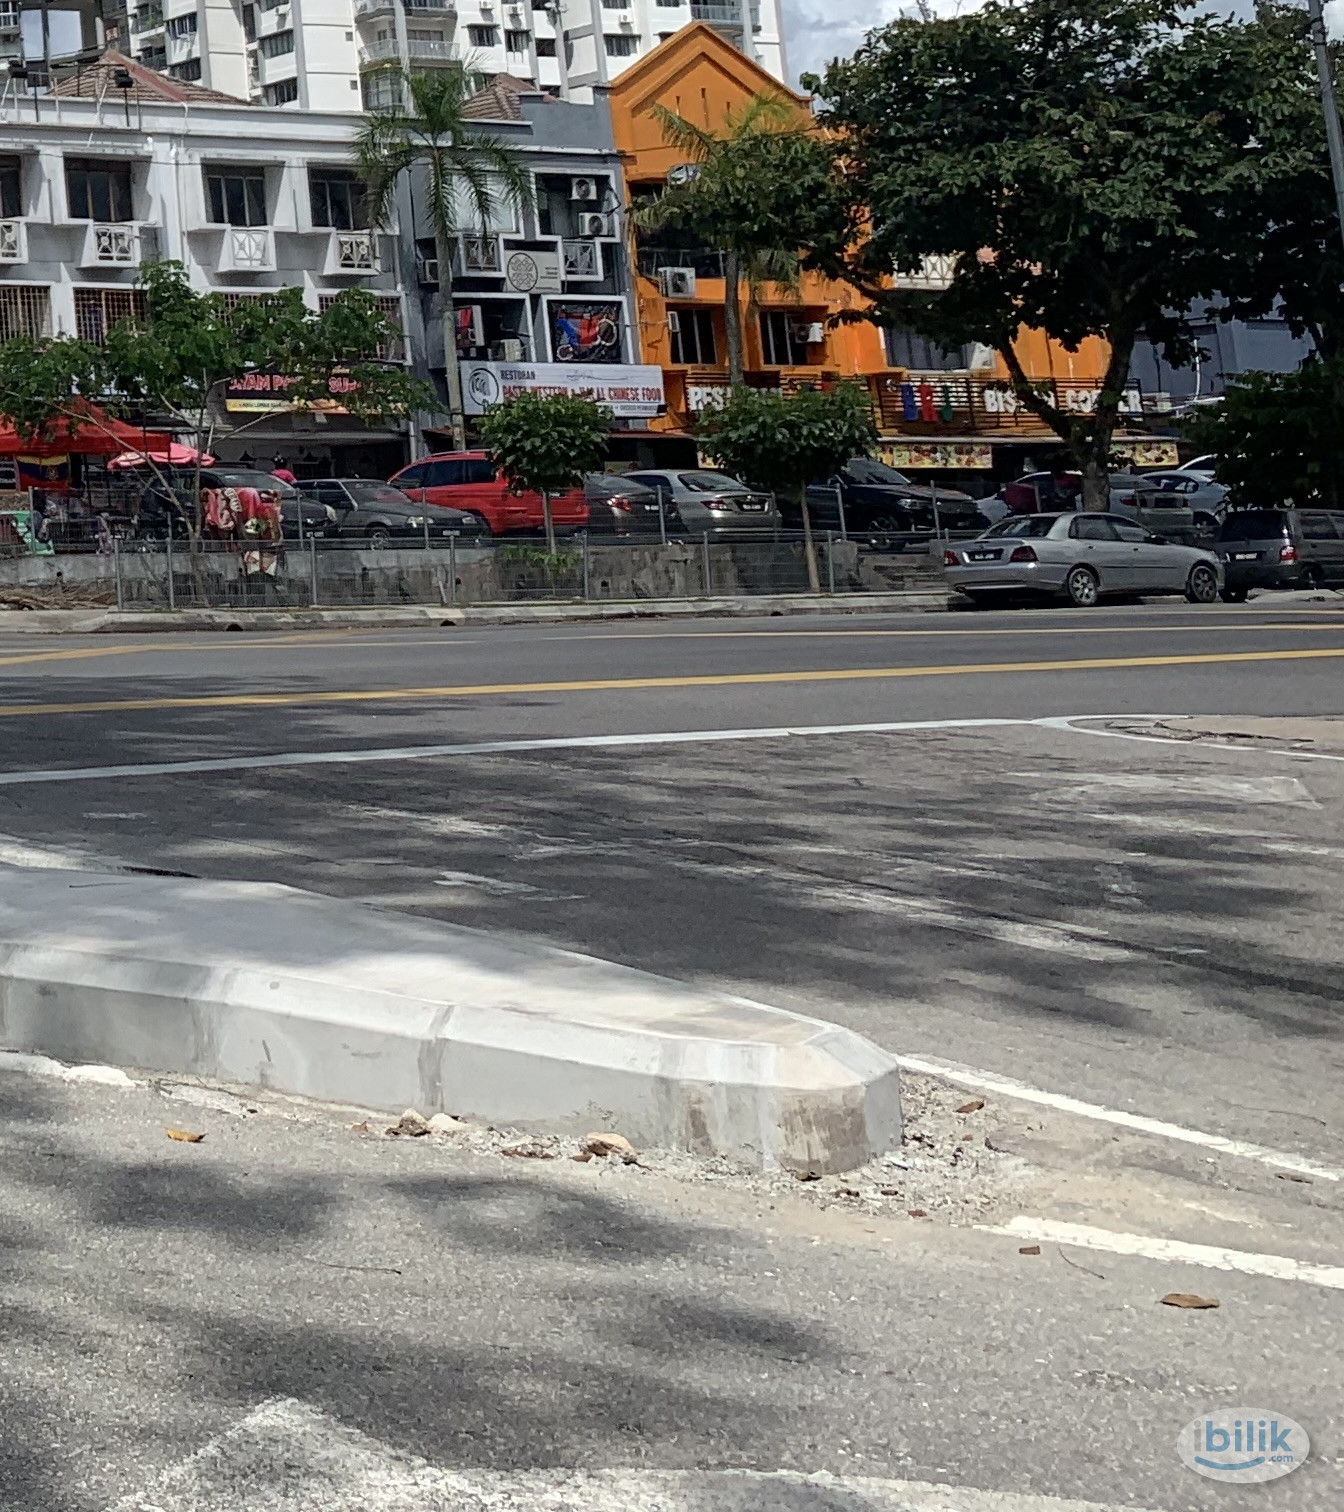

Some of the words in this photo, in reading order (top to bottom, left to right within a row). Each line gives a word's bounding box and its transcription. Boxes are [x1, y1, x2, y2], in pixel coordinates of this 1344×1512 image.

[501, 369, 536, 380] RESTORAN
[608, 387, 640, 401] CHINESE
[642, 388, 661, 401] FOOD
